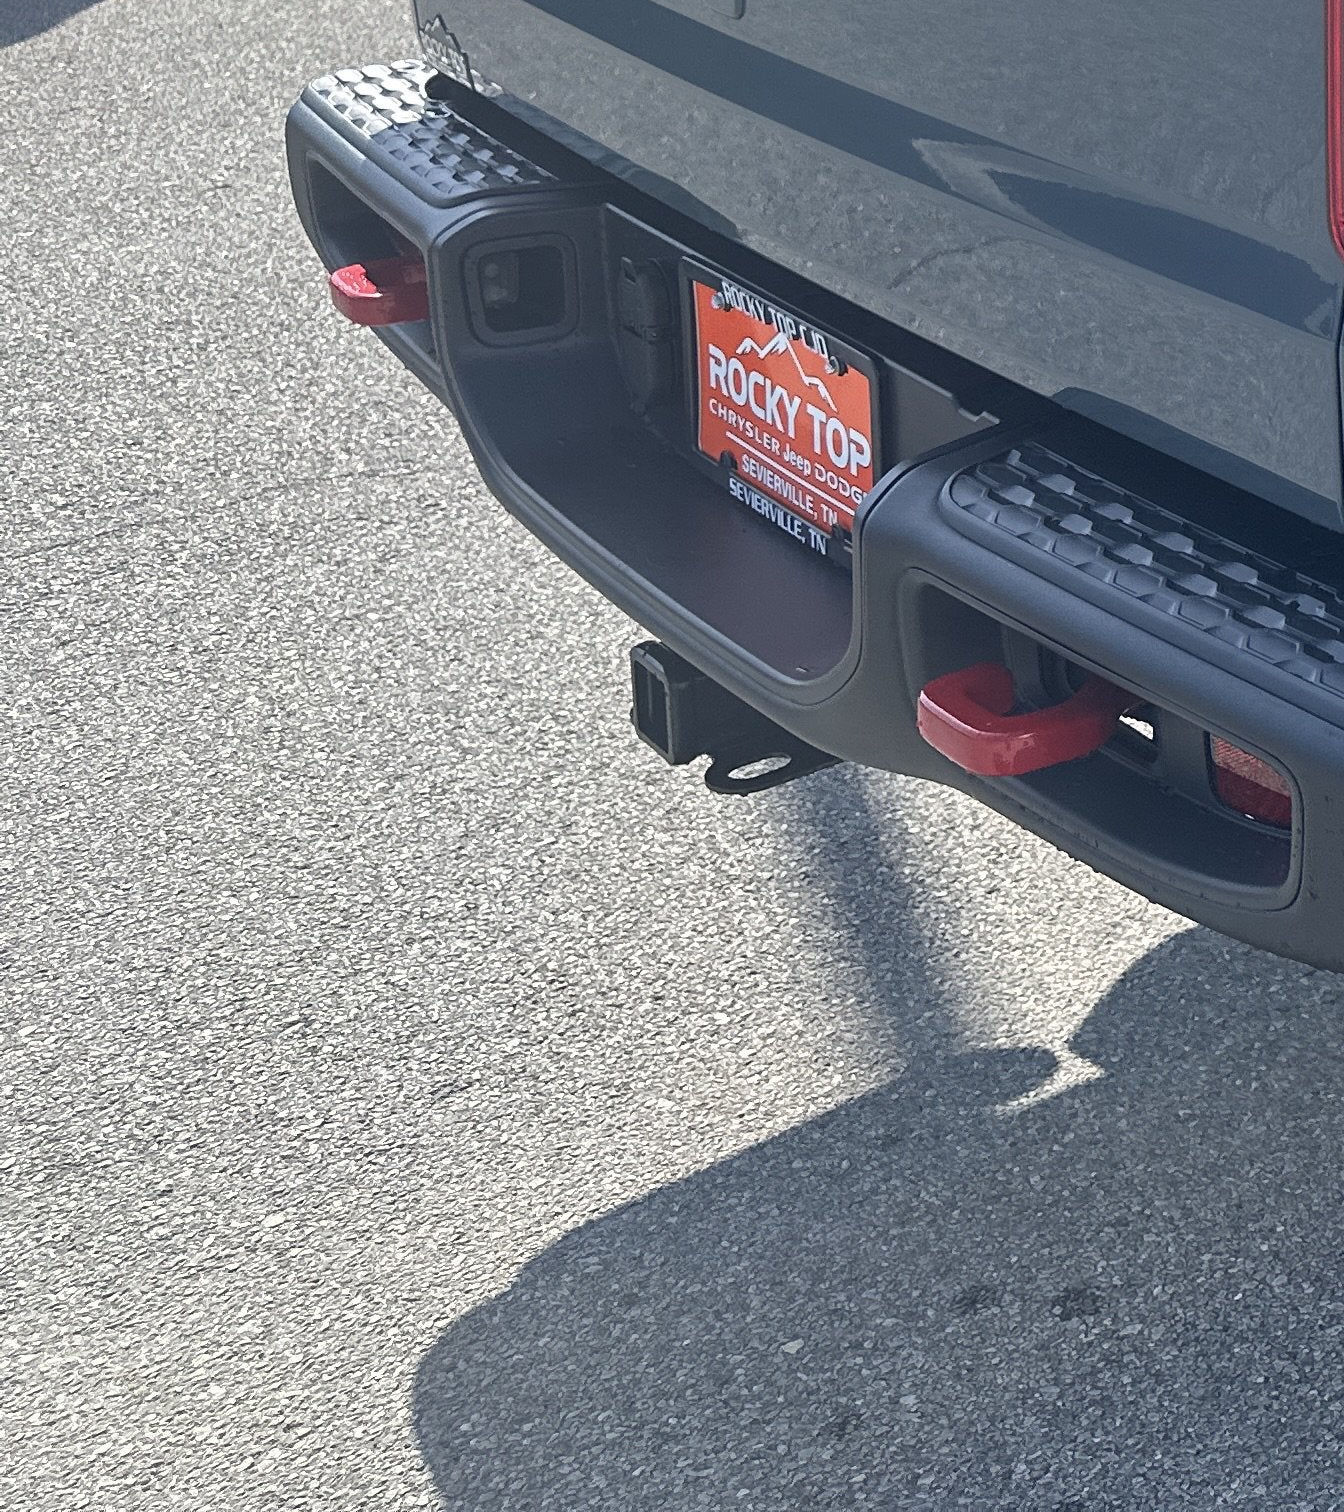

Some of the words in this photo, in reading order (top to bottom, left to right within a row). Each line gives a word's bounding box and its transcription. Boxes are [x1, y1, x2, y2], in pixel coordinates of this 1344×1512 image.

[721, 280, 766, 325] ROCKY
[767, 306, 797, 340] TOP
[800, 325, 829, 359] CJD
[708, 343, 801, 439] ROCKY
[806, 402, 872, 477] TOP
[709, 398, 780, 456] CHRYSLER
[783, 445, 812, 478] Jeep
[814, 464, 869, 505] DODG
[741, 453, 818, 521] SEVIERVILLE,
[821, 502, 838, 528] TN
[729, 476, 806, 545] SEVIERVILLE,
[809, 525, 829, 556] TN
